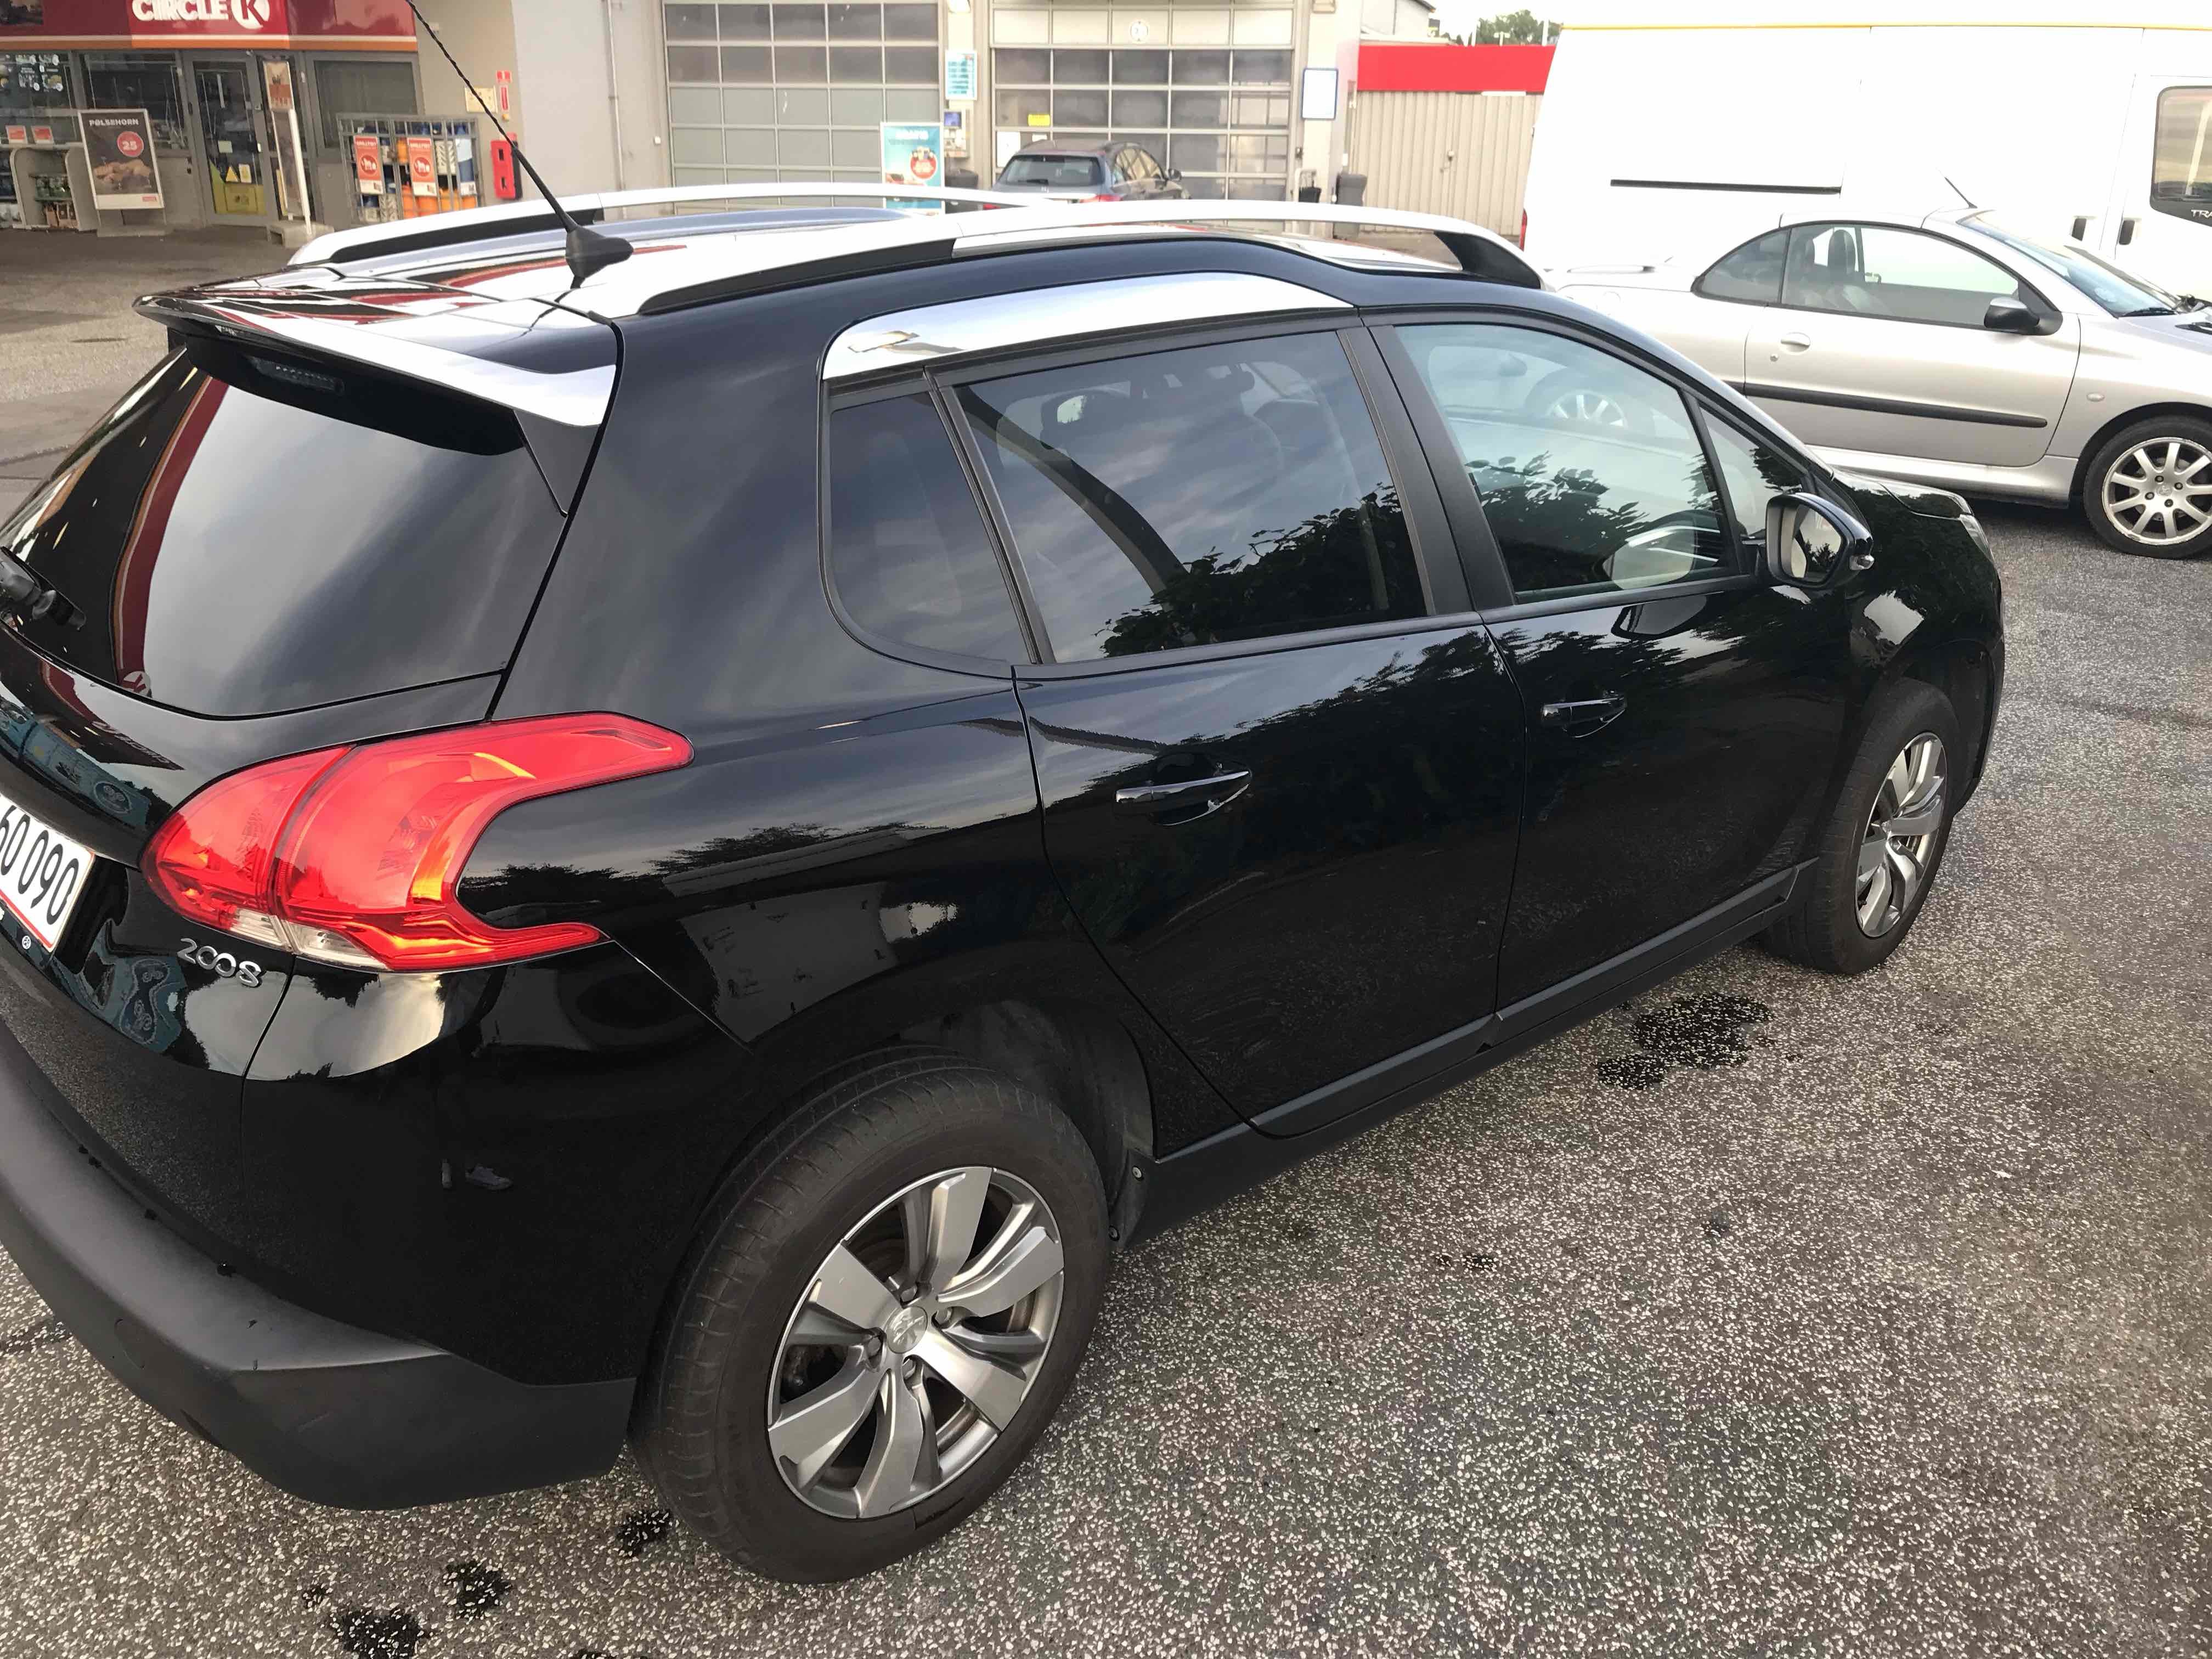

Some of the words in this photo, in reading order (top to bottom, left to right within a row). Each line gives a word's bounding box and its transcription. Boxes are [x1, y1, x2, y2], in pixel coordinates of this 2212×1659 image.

[132, 0, 228, 21] CIRCLE
[231, 0, 270, 29] K
[18, 830, 79, 925] 090
[177, 938, 261, 988] 2008
